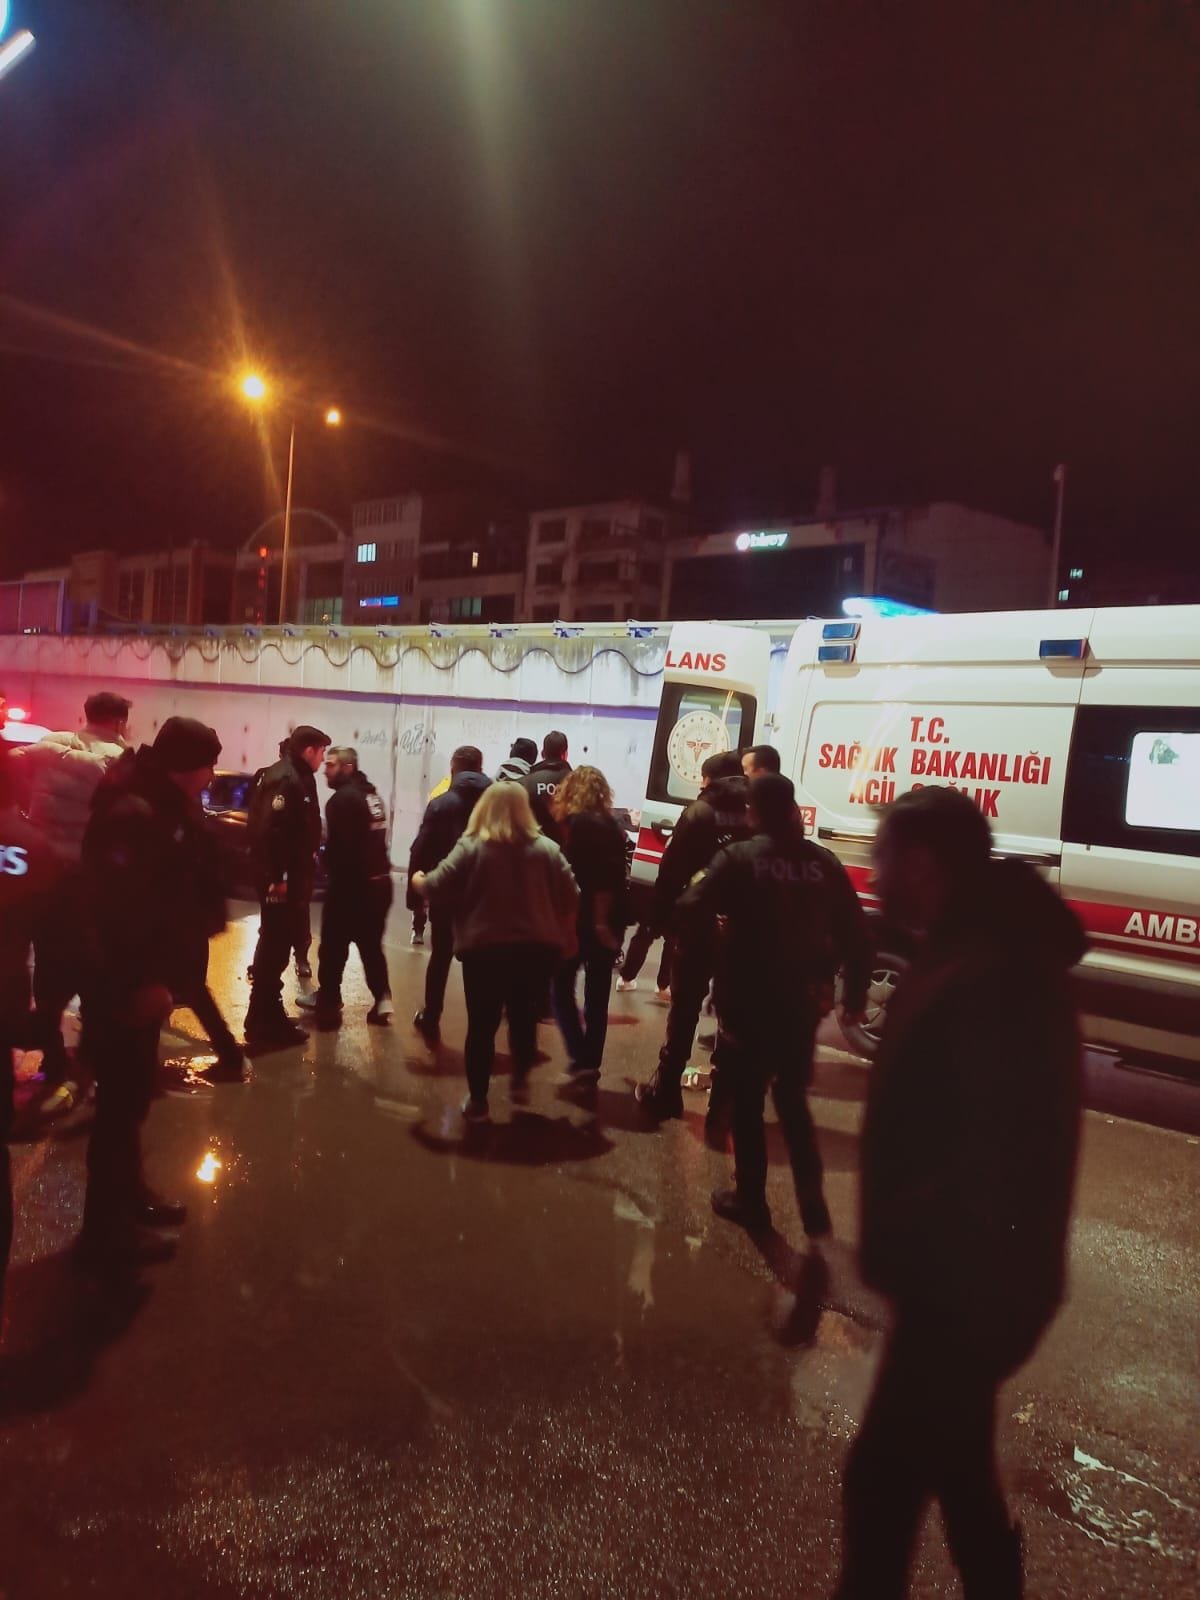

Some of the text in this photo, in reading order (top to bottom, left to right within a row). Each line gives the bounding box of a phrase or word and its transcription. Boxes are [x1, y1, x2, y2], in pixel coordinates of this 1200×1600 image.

[665, 650, 727, 672] LANS
[910, 716, 950, 743] T.C.
[818, 740, 1052, 785] SAĞLIK BAKANLIĞI
[536, 782, 557, 796] PO
[848, 775, 897, 805] ACİL
[1123, 911, 1200, 944] AMB
